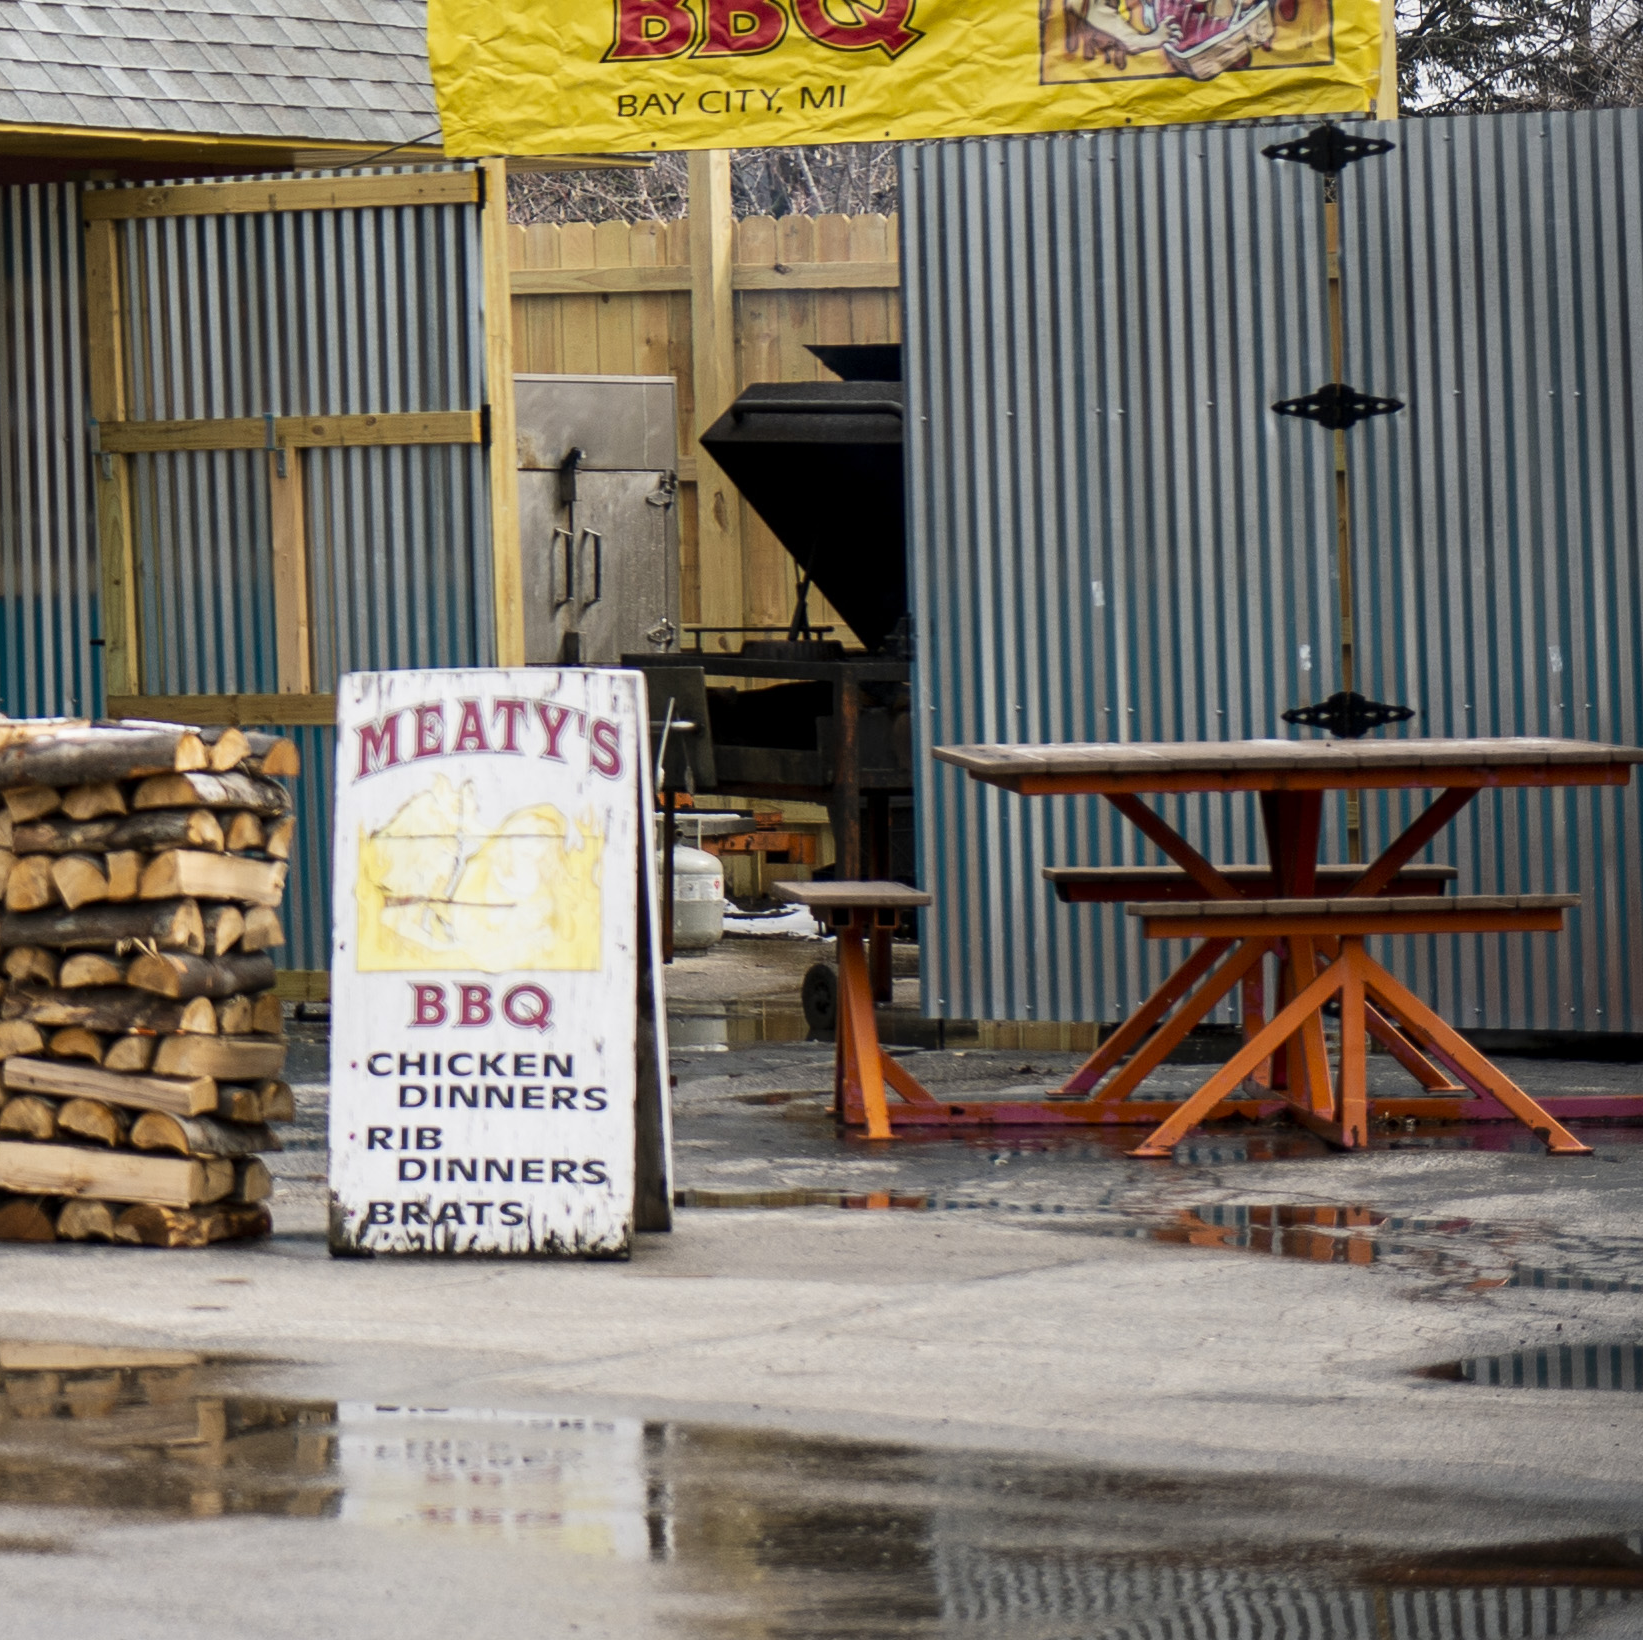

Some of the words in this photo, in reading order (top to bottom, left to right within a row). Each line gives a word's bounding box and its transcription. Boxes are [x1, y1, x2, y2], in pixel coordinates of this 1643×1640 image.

[616, 90, 685, 118] BAY
[697, 86, 785, 116] CITY,
[799, 84, 847, 110] MI
[352, 694, 625, 784] MEATY'S
[407, 981, 557, 1034] BBQ
[367, 1052, 573, 1078] CHICKEN
[399, 1085, 609, 1111] DINNERS
[367, 1126, 443, 1150] RIB
[398, 1158, 609, 1185] DINNERS
[367, 1201, 525, 1226] BRATS
